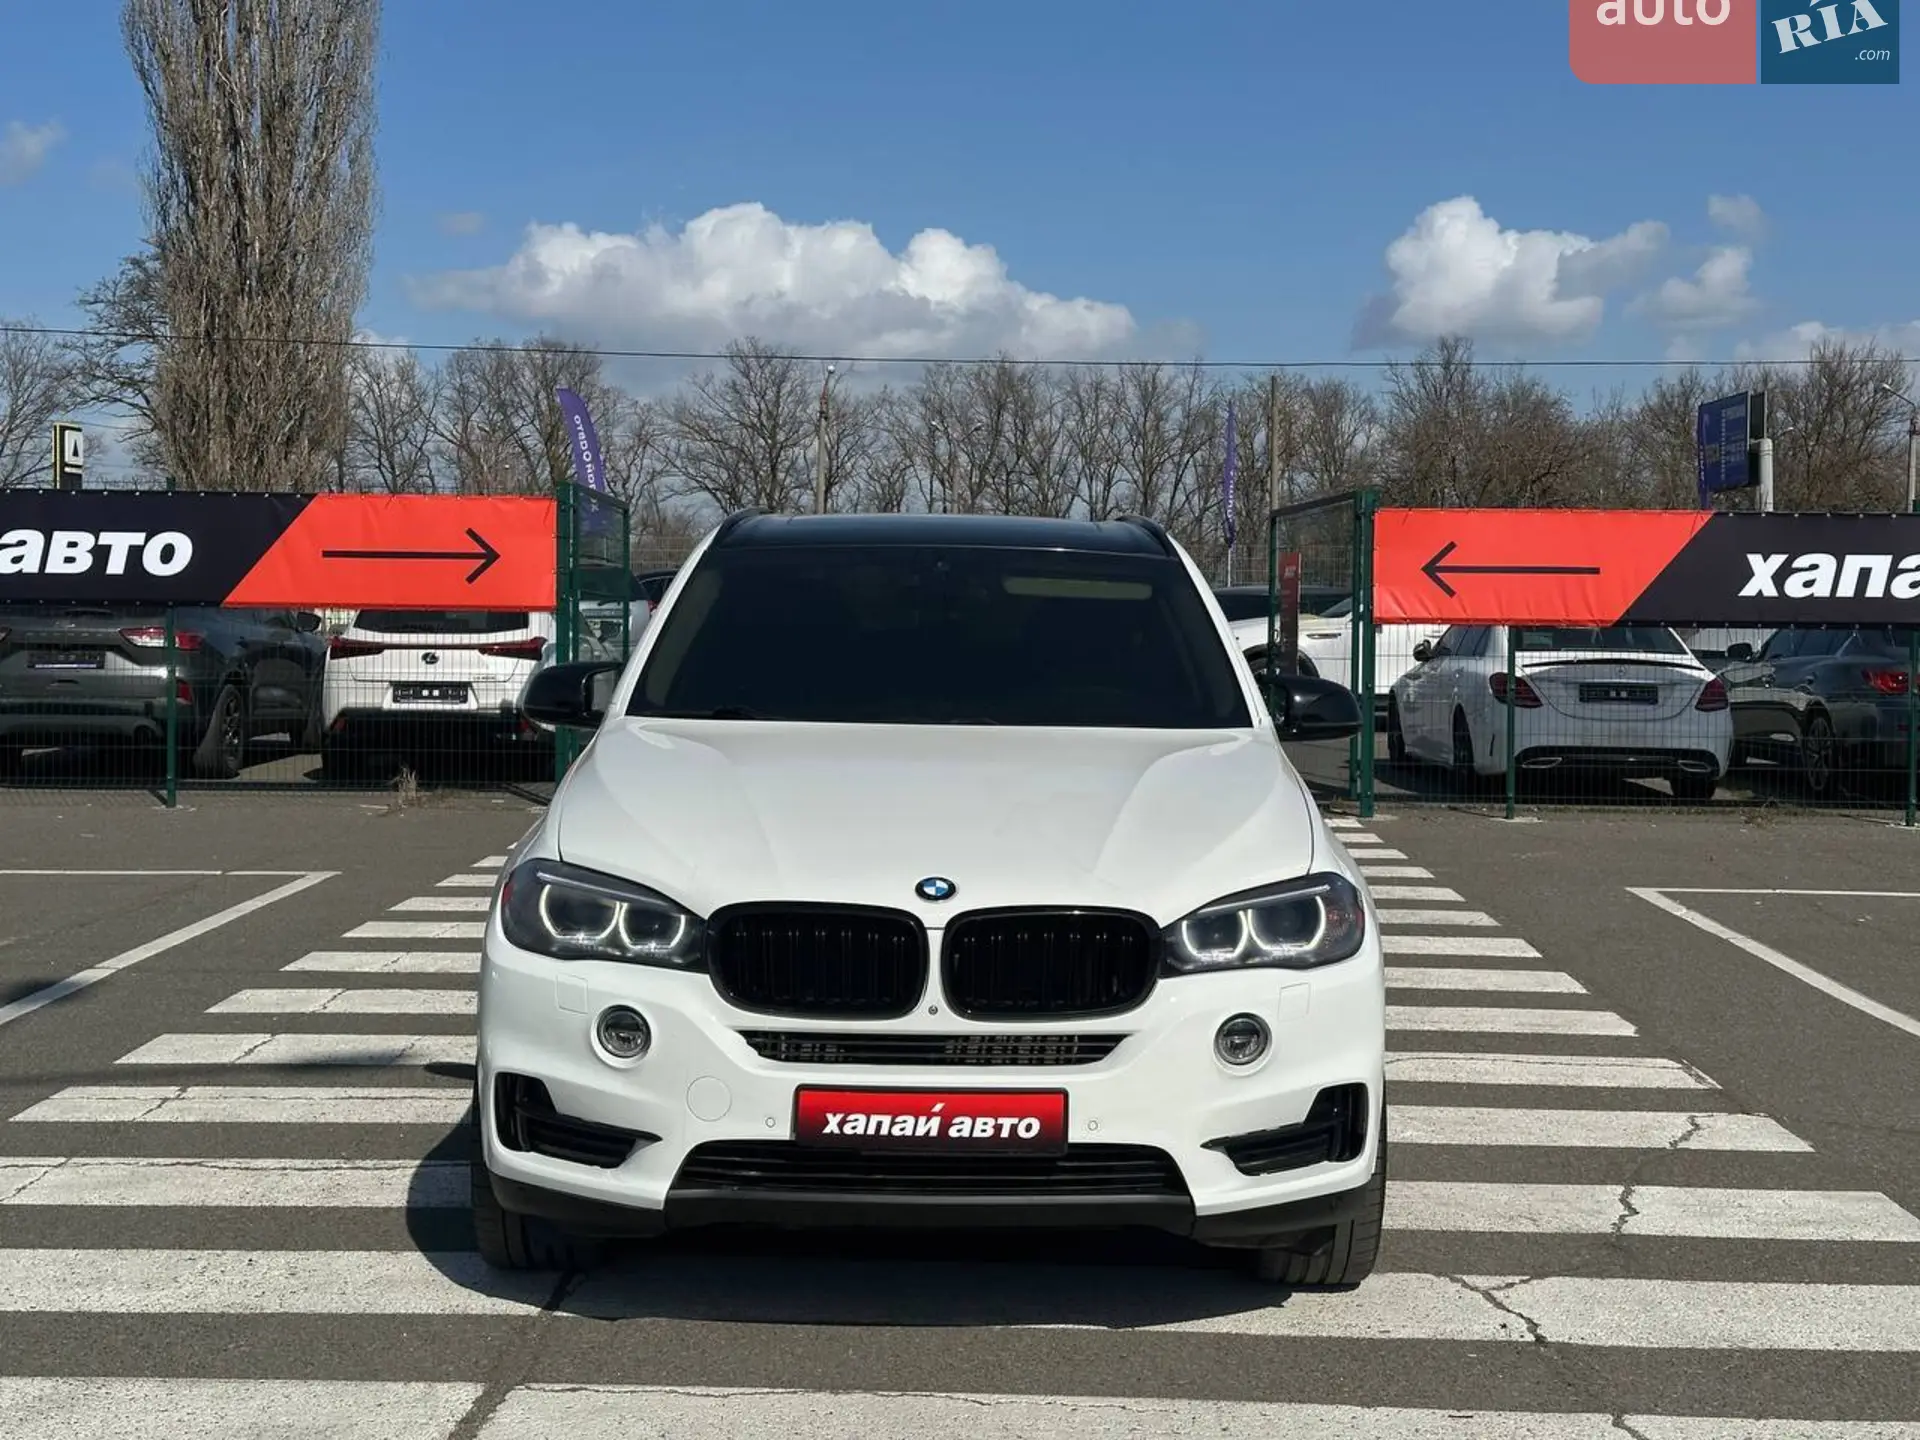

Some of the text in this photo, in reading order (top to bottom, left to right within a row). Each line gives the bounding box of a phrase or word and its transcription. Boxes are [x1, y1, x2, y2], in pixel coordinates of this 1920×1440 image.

[0, 529, 193, 577] авто
[822, 1102, 1041, 1140] хапай авто
